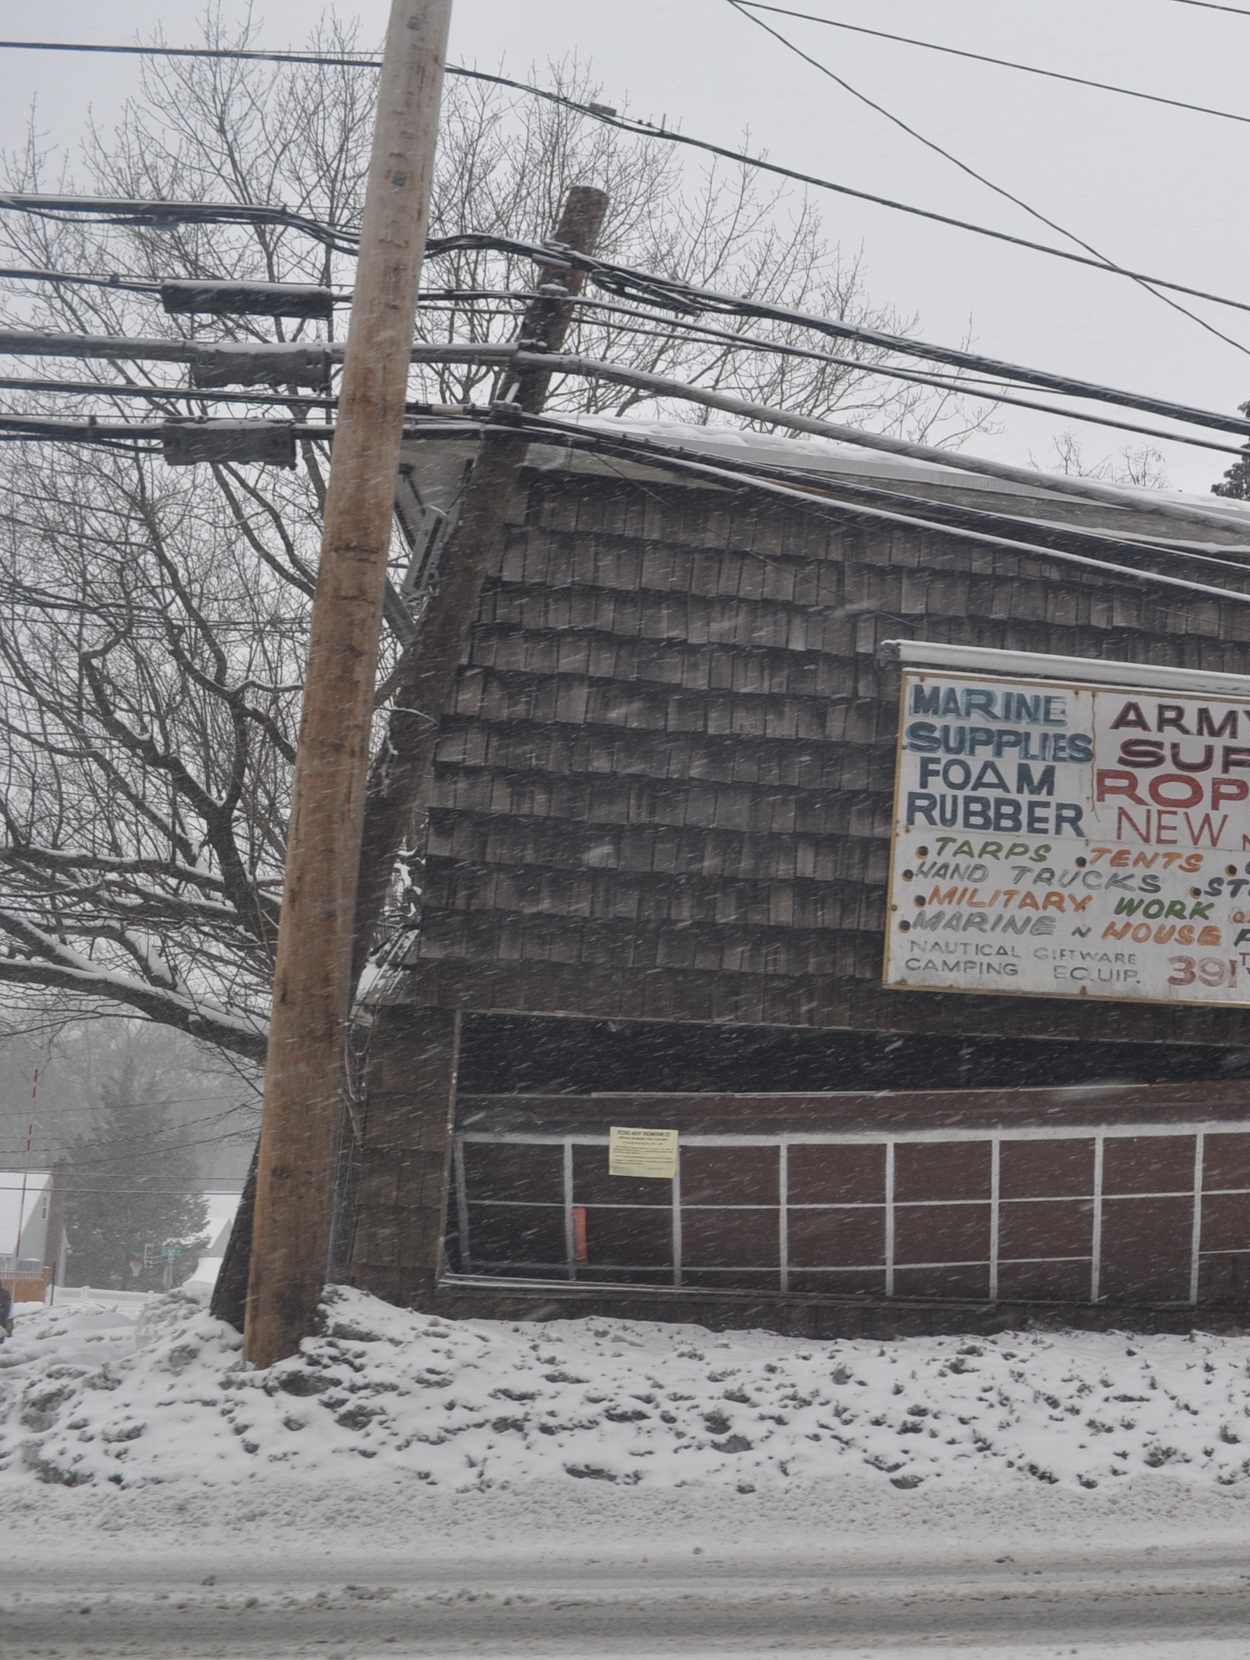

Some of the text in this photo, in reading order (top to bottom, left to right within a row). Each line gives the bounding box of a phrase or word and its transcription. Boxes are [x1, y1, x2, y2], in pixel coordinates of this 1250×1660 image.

[909, 684, 1068, 727] MARINE
[905, 721, 1094, 764] SUPPLIES
[919, 756, 1056, 796] FOAM
[906, 791, 1085, 838] RUBBER
[1116, 806, 1229, 848] NEW
[935, 836, 1052, 863] TARPS
[1089, 847, 1204, 873] TENTS
[915, 860, 989, 883] HAND
[1010, 865, 1162, 894] TRUCKS
[927, 885, 1093, 913] MILITARY
[1113, 896, 1215, 920] WORK
[911, 910, 1057, 936] MARINE
[1101, 921, 1221, 947] HOUSE
[905, 957, 1018, 977] CAMPING
[910, 940, 1021, 959] NAUTICAL
[1167, 955, 1238, 988] 391
